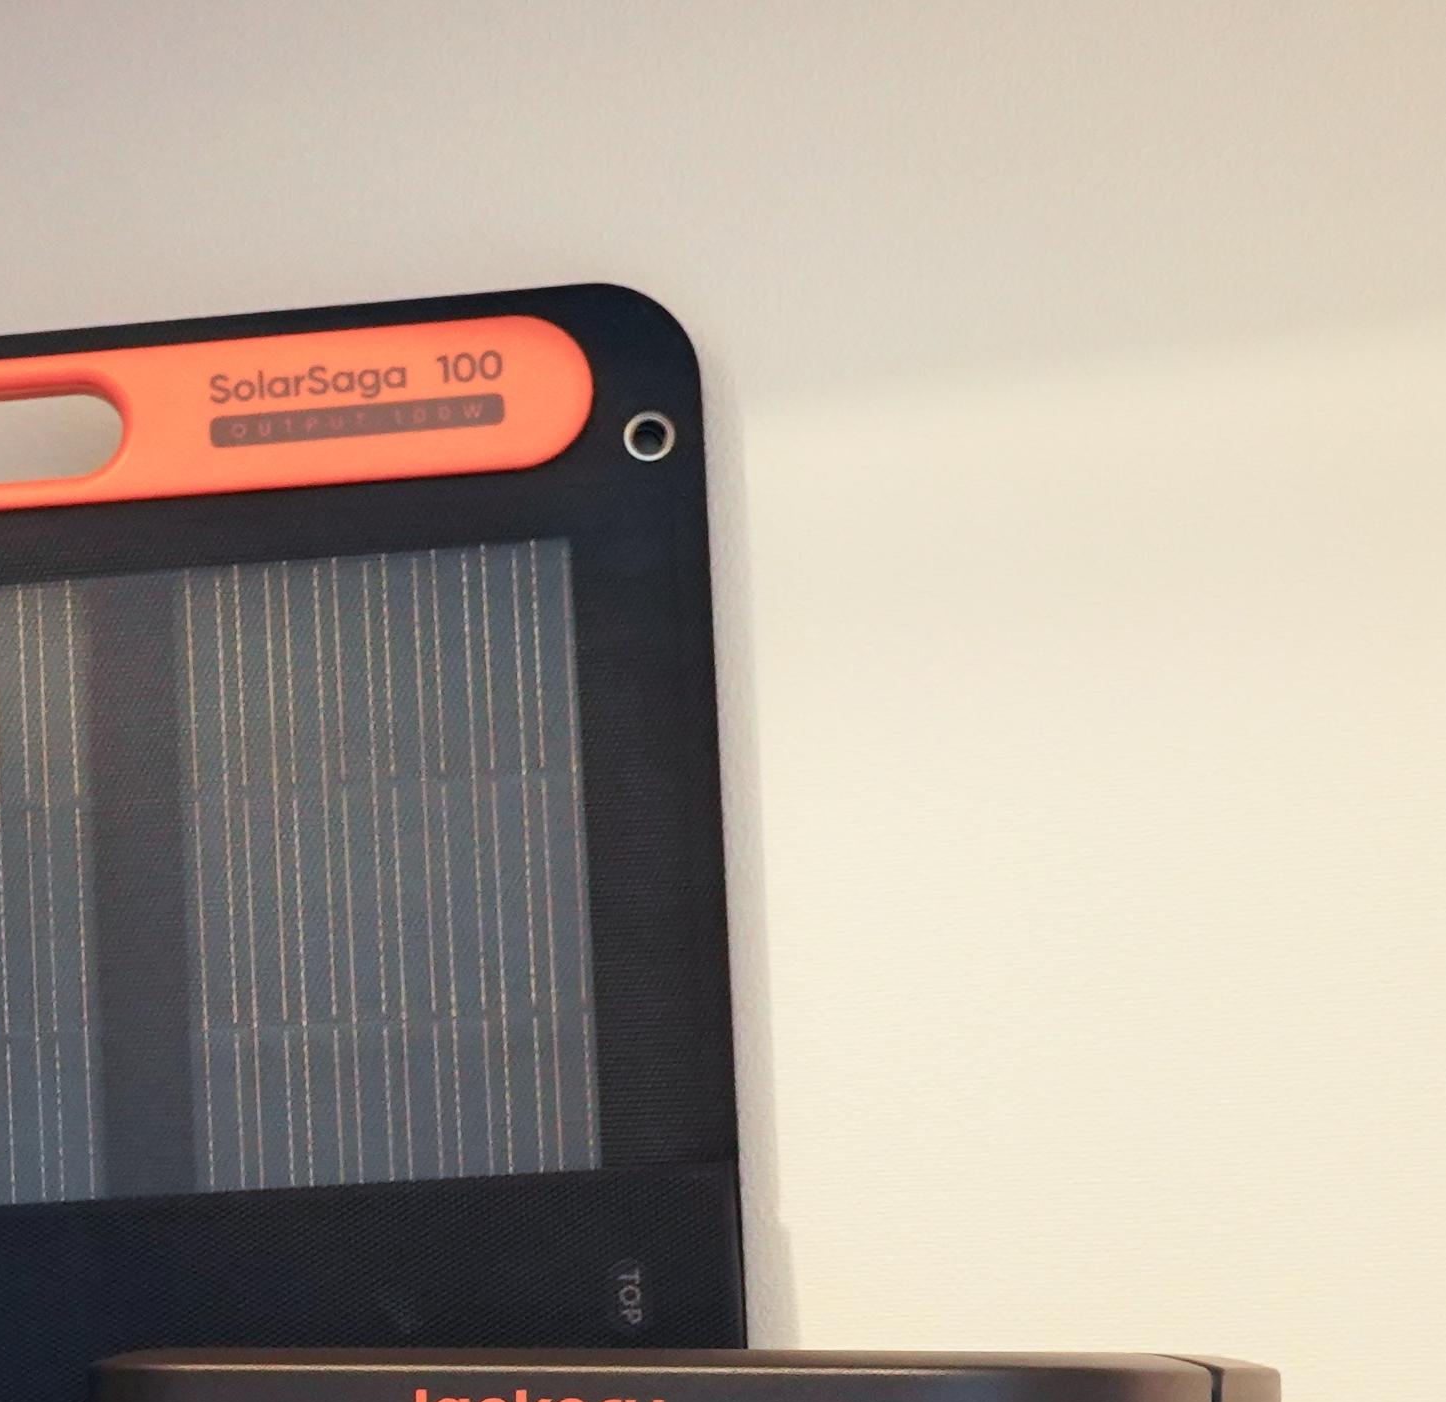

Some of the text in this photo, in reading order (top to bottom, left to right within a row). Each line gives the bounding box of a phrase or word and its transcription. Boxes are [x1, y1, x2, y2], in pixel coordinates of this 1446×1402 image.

[209, 349, 503, 404] SolarSaga 100
[616, 1266, 644, 1326] TOP
